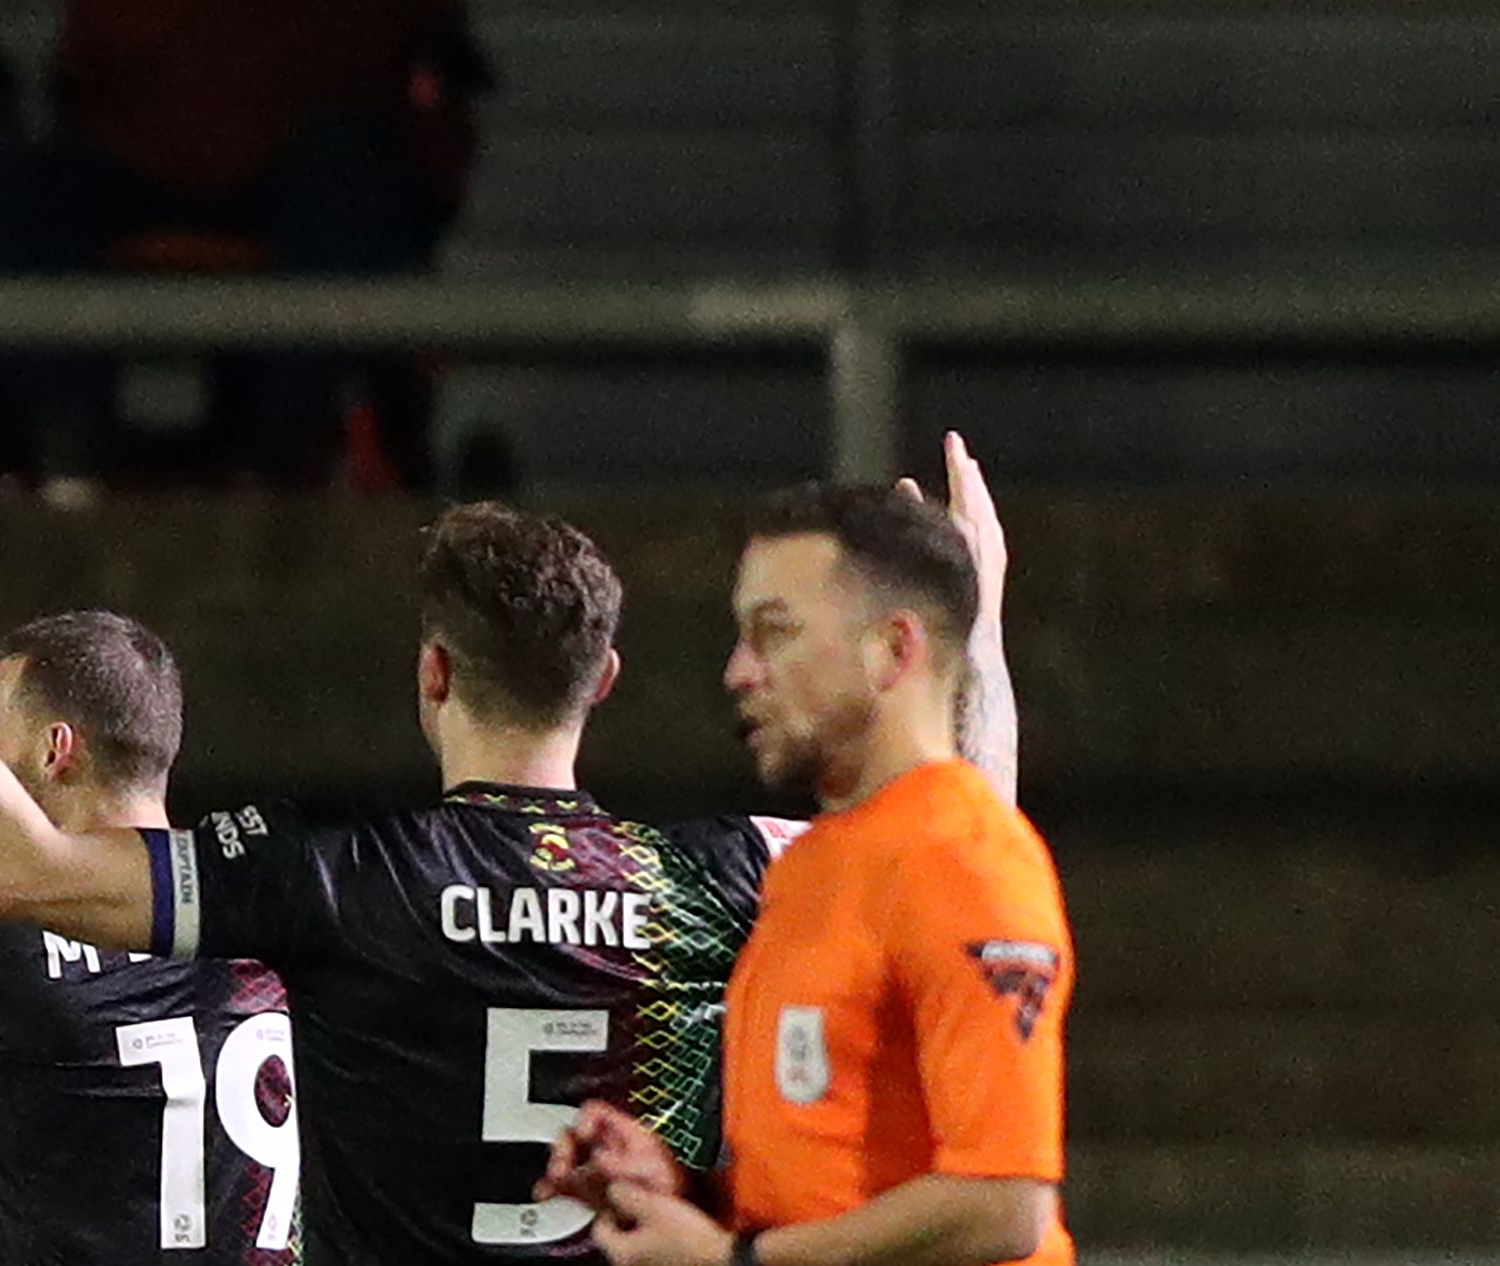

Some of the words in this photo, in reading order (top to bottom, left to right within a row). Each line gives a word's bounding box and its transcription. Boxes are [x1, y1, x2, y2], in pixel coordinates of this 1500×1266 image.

[441, 885, 652, 949] CLARKE
[115, 1012, 301, 1250] 19
[472, 1007, 609, 1244] 5
